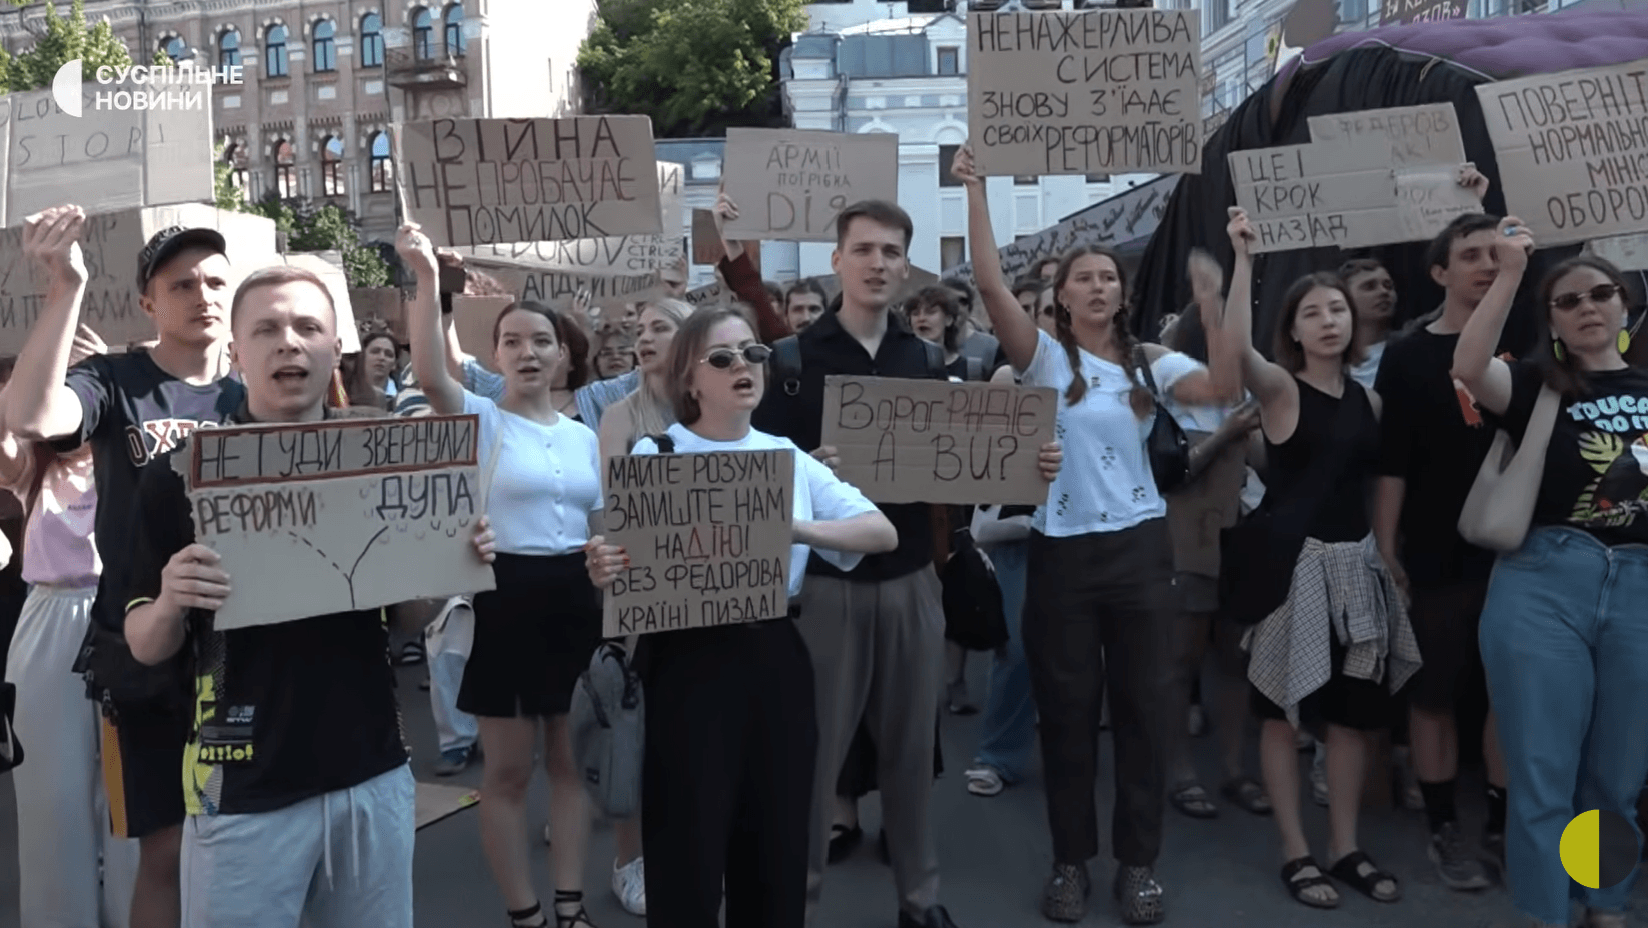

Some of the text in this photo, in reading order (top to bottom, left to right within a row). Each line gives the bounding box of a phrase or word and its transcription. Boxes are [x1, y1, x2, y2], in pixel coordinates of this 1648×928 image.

[976, 11, 1192, 52] НЕНАЖЕРЛИВА
[1056, 51, 1196, 84] СИСТЕМА
[982, 86, 1181, 119] ЗНОВУ З'ЇДАЄ
[432, 117, 621, 162] ВІЙНА
[1045, 119, 1197, 172] РЕФОРМАТОРІВ
[410, 159, 468, 209] НЕ
[475, 156, 637, 206] ПРОБАЧАЄ
[778, 171, 851, 187] ПОТРІБНА
[1247, 153, 1286, 182] ЦЕ
[1254, 182, 1323, 214] КРОК
[1547, 186, 1648, 229] ОБОРО
[446, 200, 609, 247] ПОМИЛОК
[1259, 211, 1348, 247] НАЗАД
[200, 420, 471, 480] НЕ ТУДИ ЗВЕРНУЛИ
[693, 451, 776, 483] РОЗУМ!
[872, 431, 896, 482] А
[197, 472, 474, 536] РЕФОРМИ ДУПА
[735, 486, 786, 523] НАМ
[664, 556, 784, 596] ФЕДОРОВА
[618, 588, 776, 634] КРАЇНІ ПИЗДА!
